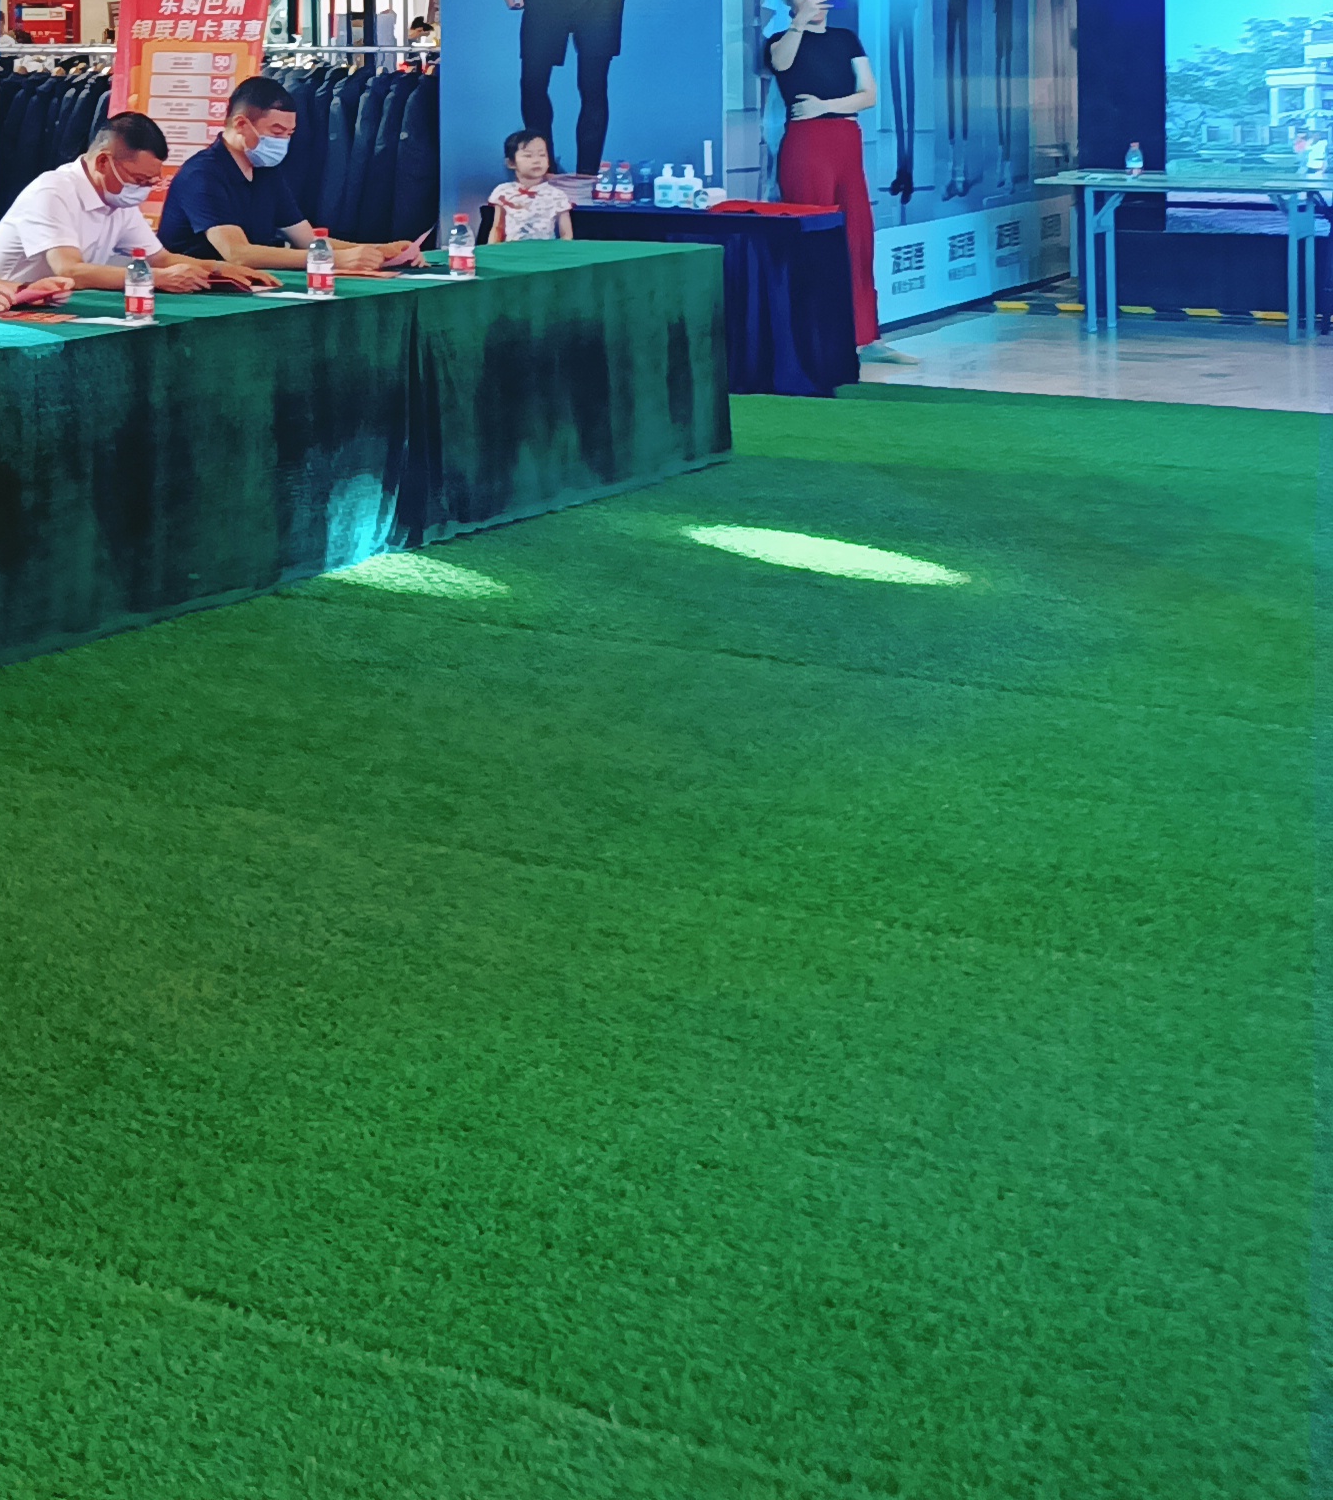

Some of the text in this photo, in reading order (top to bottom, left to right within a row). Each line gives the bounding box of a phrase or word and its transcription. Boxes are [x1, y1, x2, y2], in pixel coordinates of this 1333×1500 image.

[130, 19, 265, 42] 银联刷卡聚惠
